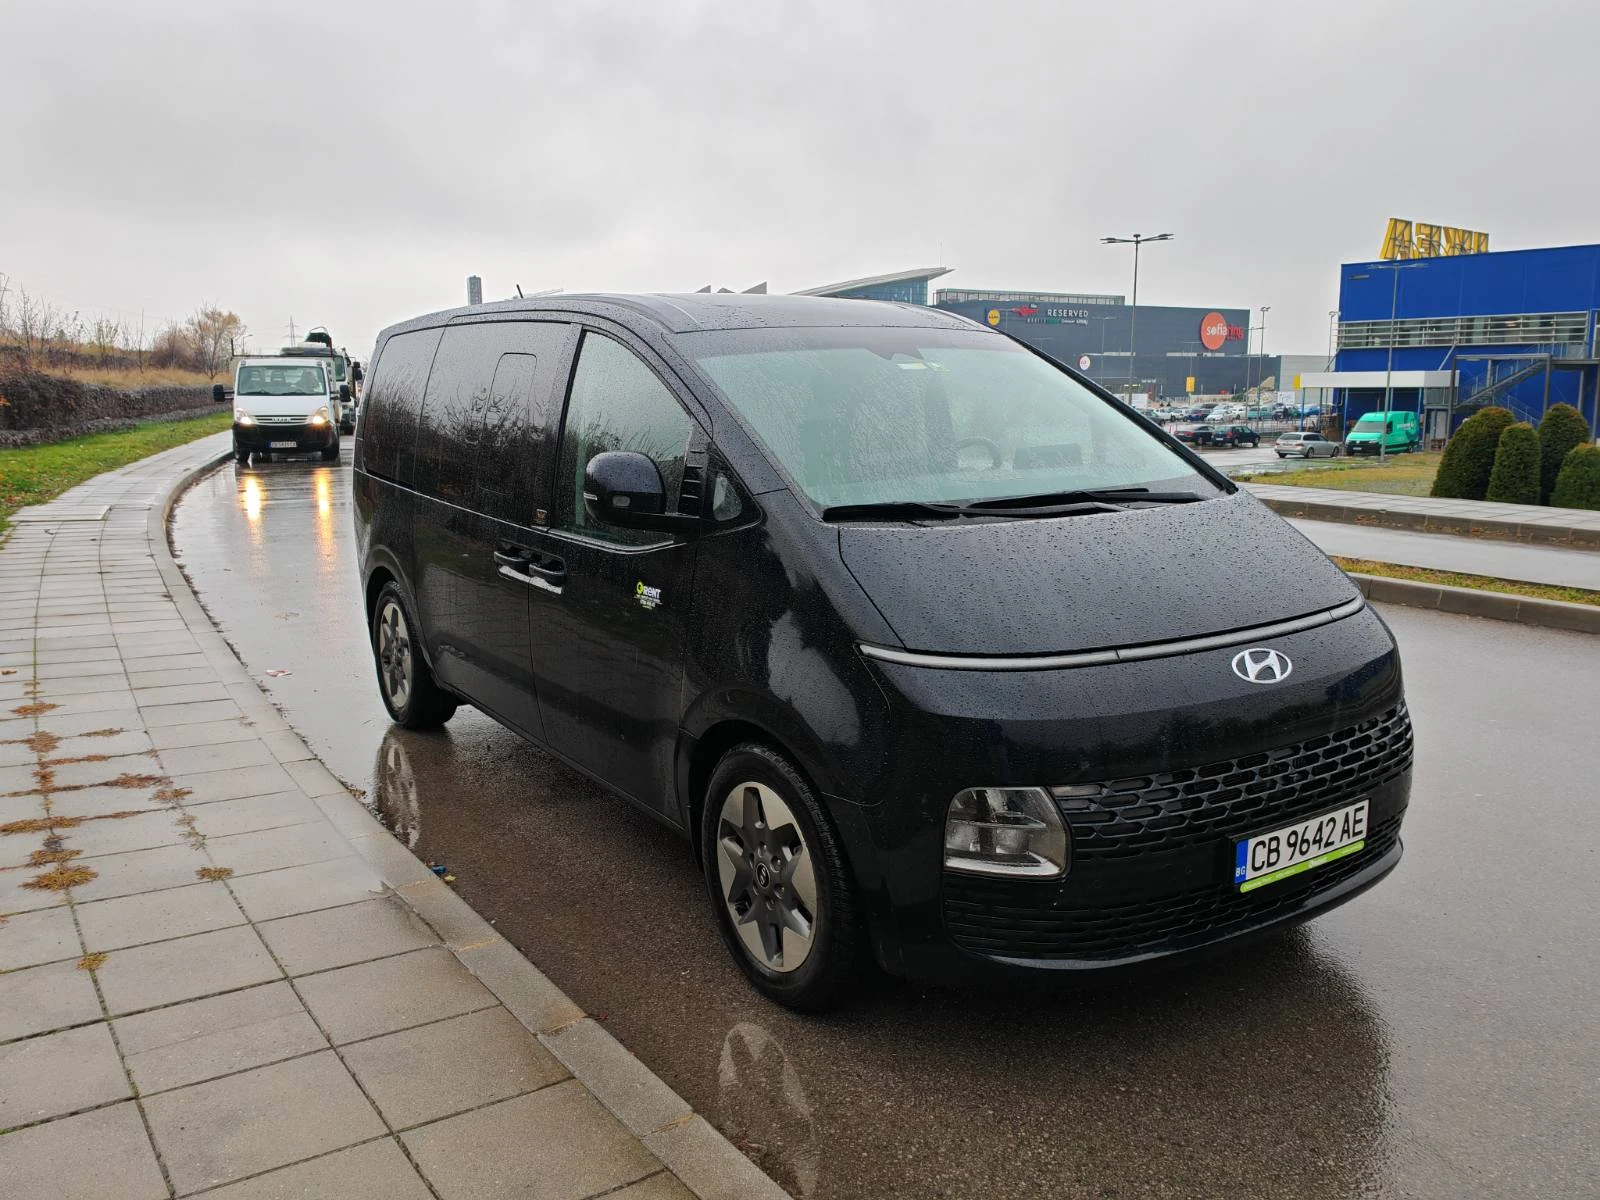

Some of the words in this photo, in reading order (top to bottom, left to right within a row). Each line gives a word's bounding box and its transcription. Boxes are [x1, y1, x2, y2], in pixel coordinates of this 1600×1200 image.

[1047, 309, 1089, 318] RESERVED
[1251, 835, 1280, 872] CB
[1287, 816, 1336, 861] 9642
[1340, 805, 1365, 842] AE
[1235, 866, 1246, 877] BG
